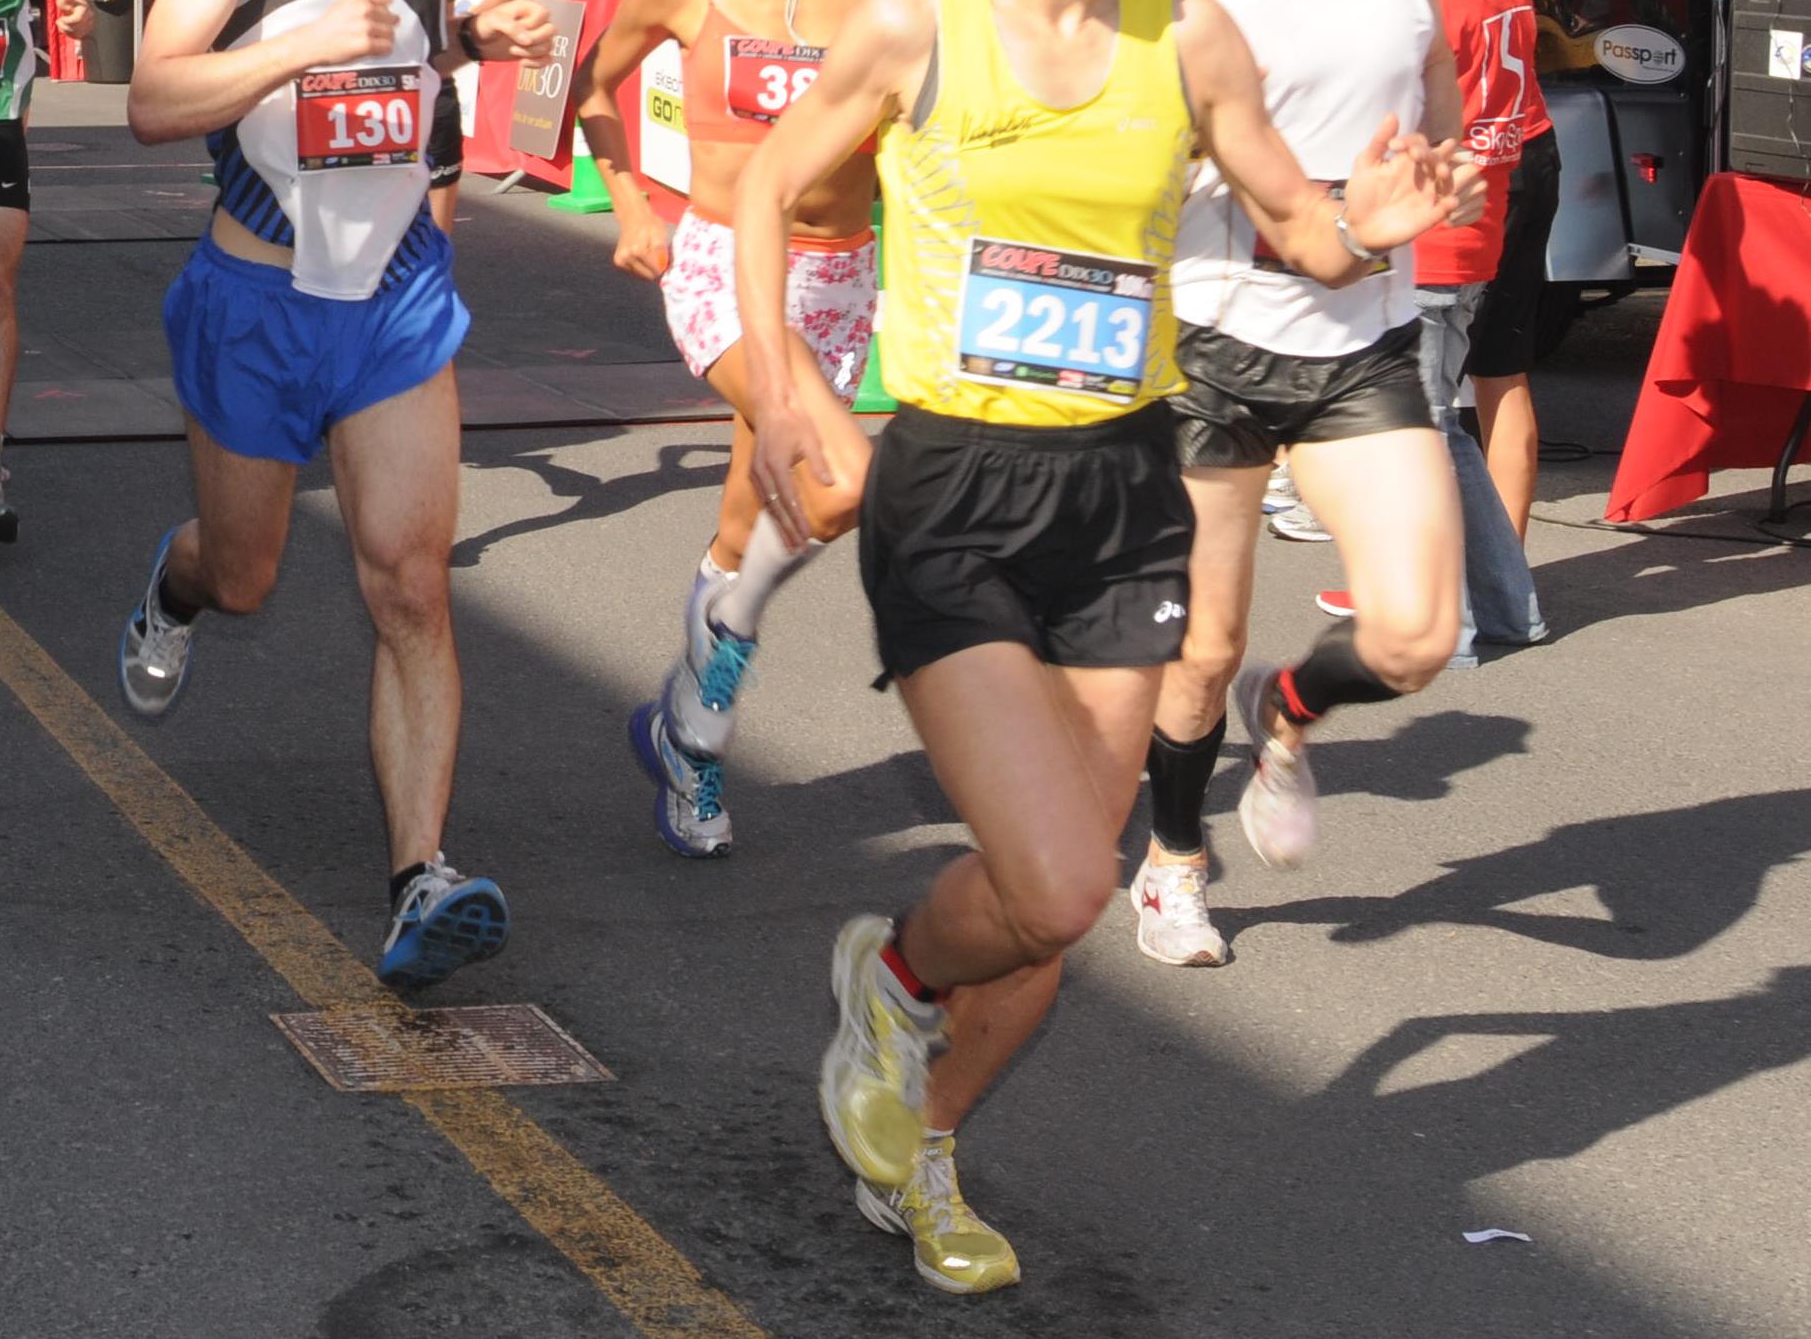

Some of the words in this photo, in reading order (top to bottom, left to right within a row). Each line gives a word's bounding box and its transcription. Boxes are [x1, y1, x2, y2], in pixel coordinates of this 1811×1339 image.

[302, 72, 358, 91] COUPE
[327, 99, 413, 149] 130
[981, 245, 1060, 277] COUPE
[976, 288, 1143, 369] 2213
